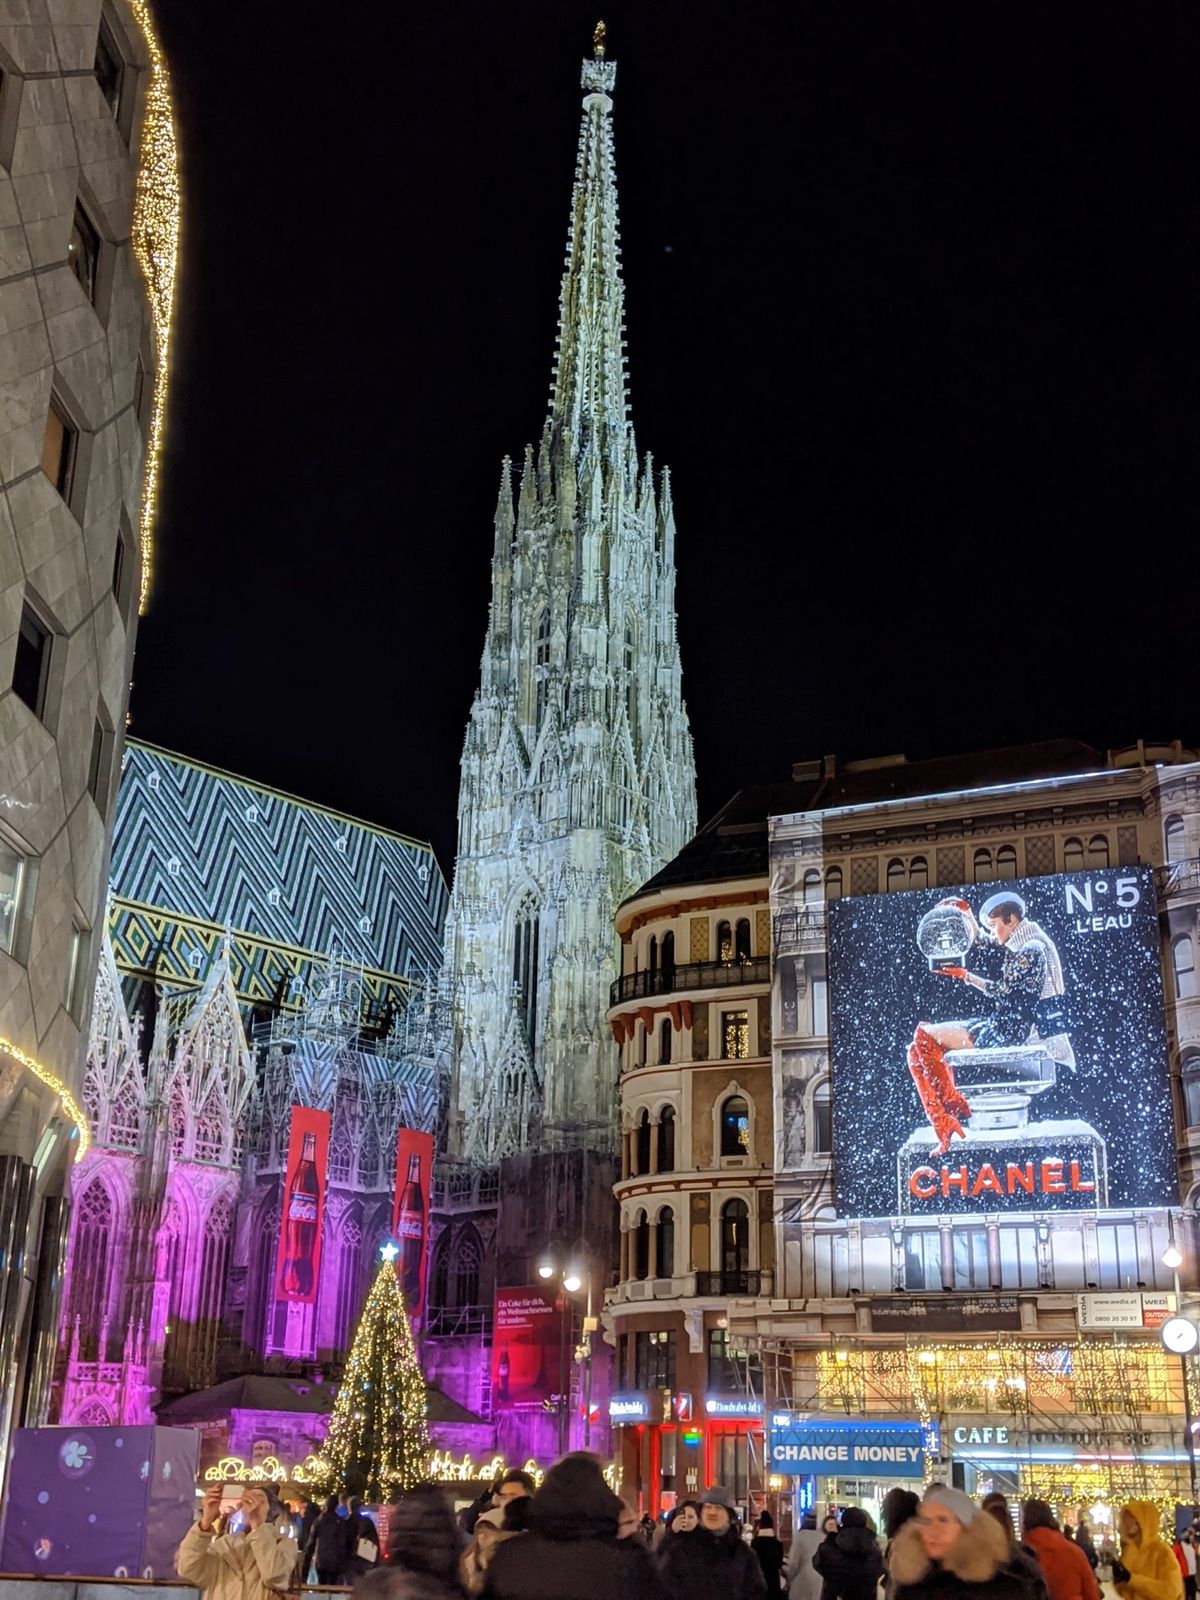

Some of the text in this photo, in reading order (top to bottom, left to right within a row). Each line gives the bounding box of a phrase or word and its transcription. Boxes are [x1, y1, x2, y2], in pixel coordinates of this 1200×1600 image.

[1115, 877, 1140, 908] 5
[1076, 913, 1132, 934] L'EAU
[909, 1157, 1095, 1199] CHANEL
[507, 1299, 522, 1308] Coke
[522, 1298, 531, 1306] für
[953, 1426, 1009, 1444] CAFÉ
[773, 1445, 920, 1462] CHANGE MONEY
